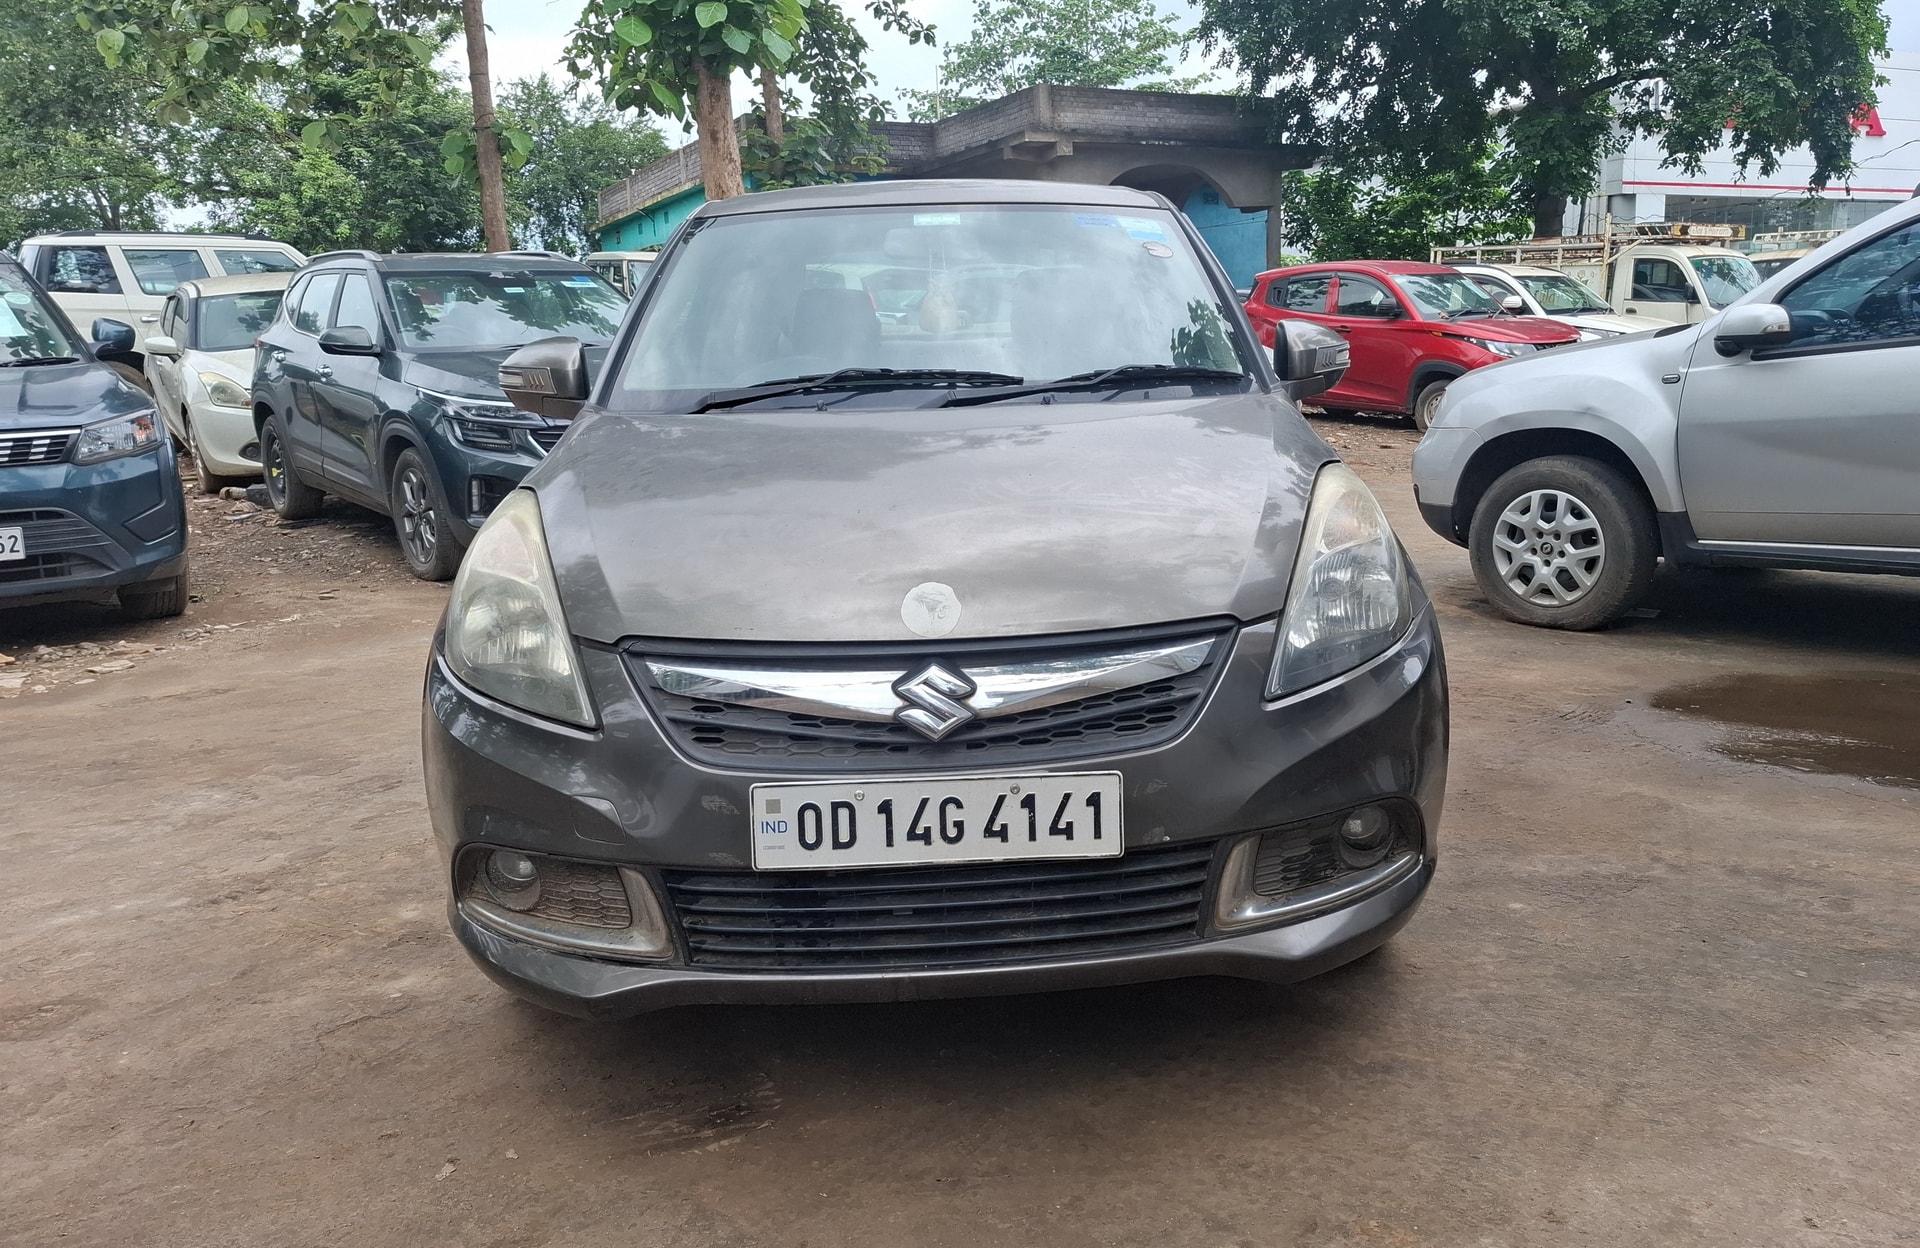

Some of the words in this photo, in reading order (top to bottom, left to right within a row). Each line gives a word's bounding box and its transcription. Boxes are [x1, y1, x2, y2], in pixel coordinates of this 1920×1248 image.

[761, 820, 788, 834] IND
[797, 801, 857, 850] OD
[877, 795, 965, 847] 14G
[983, 791, 1102, 843] 4141
